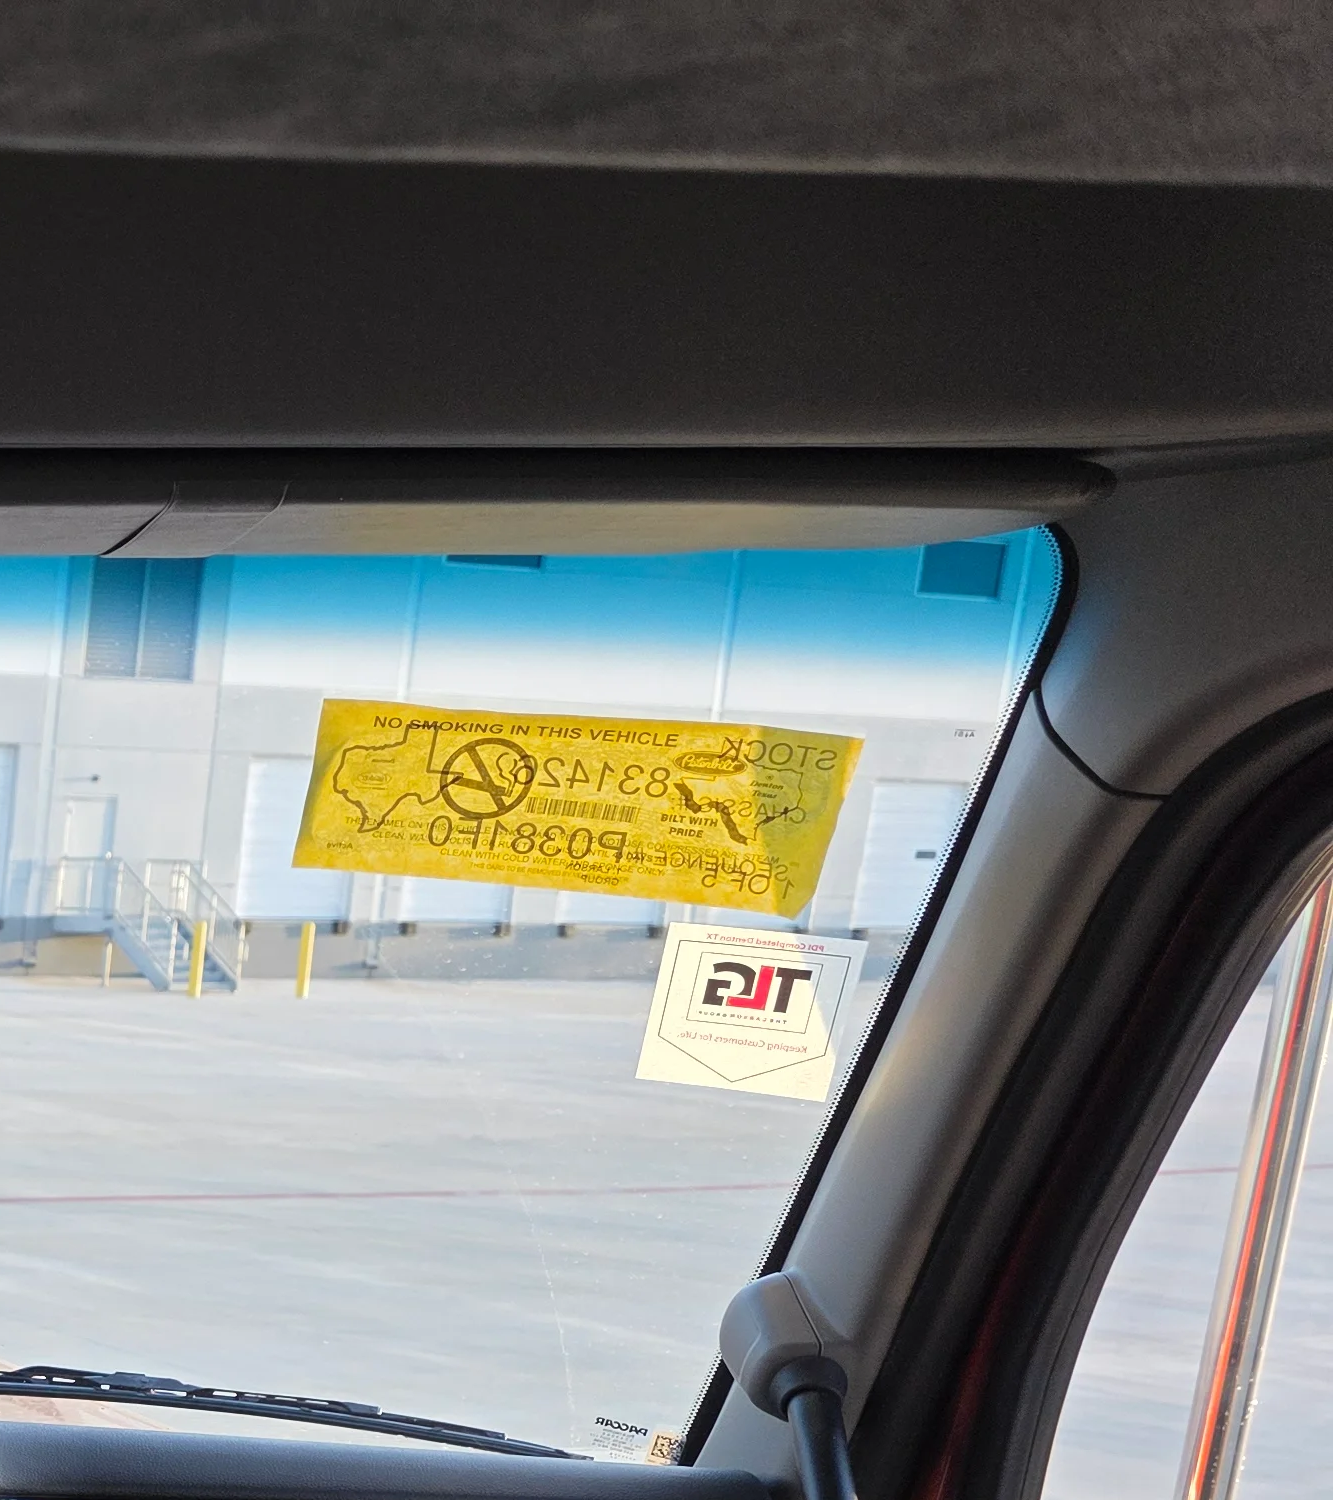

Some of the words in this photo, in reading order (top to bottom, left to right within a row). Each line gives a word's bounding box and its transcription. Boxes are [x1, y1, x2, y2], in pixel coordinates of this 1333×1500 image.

[373, 715, 403, 730] NO
[408, 718, 504, 735] SMOKING
[510, 724, 532, 737] IN
[536, 725, 583, 741] THIS
[589, 728, 680, 749] VEHICLE
[660, 814, 686, 824] BILT
[688, 816, 718, 828] WITH
[669, 827, 704, 839] PRIDE
[439, 848, 473, 859] CLEAN
[475, 850, 500, 861] WITH
[502, 852, 530, 864] COLD
